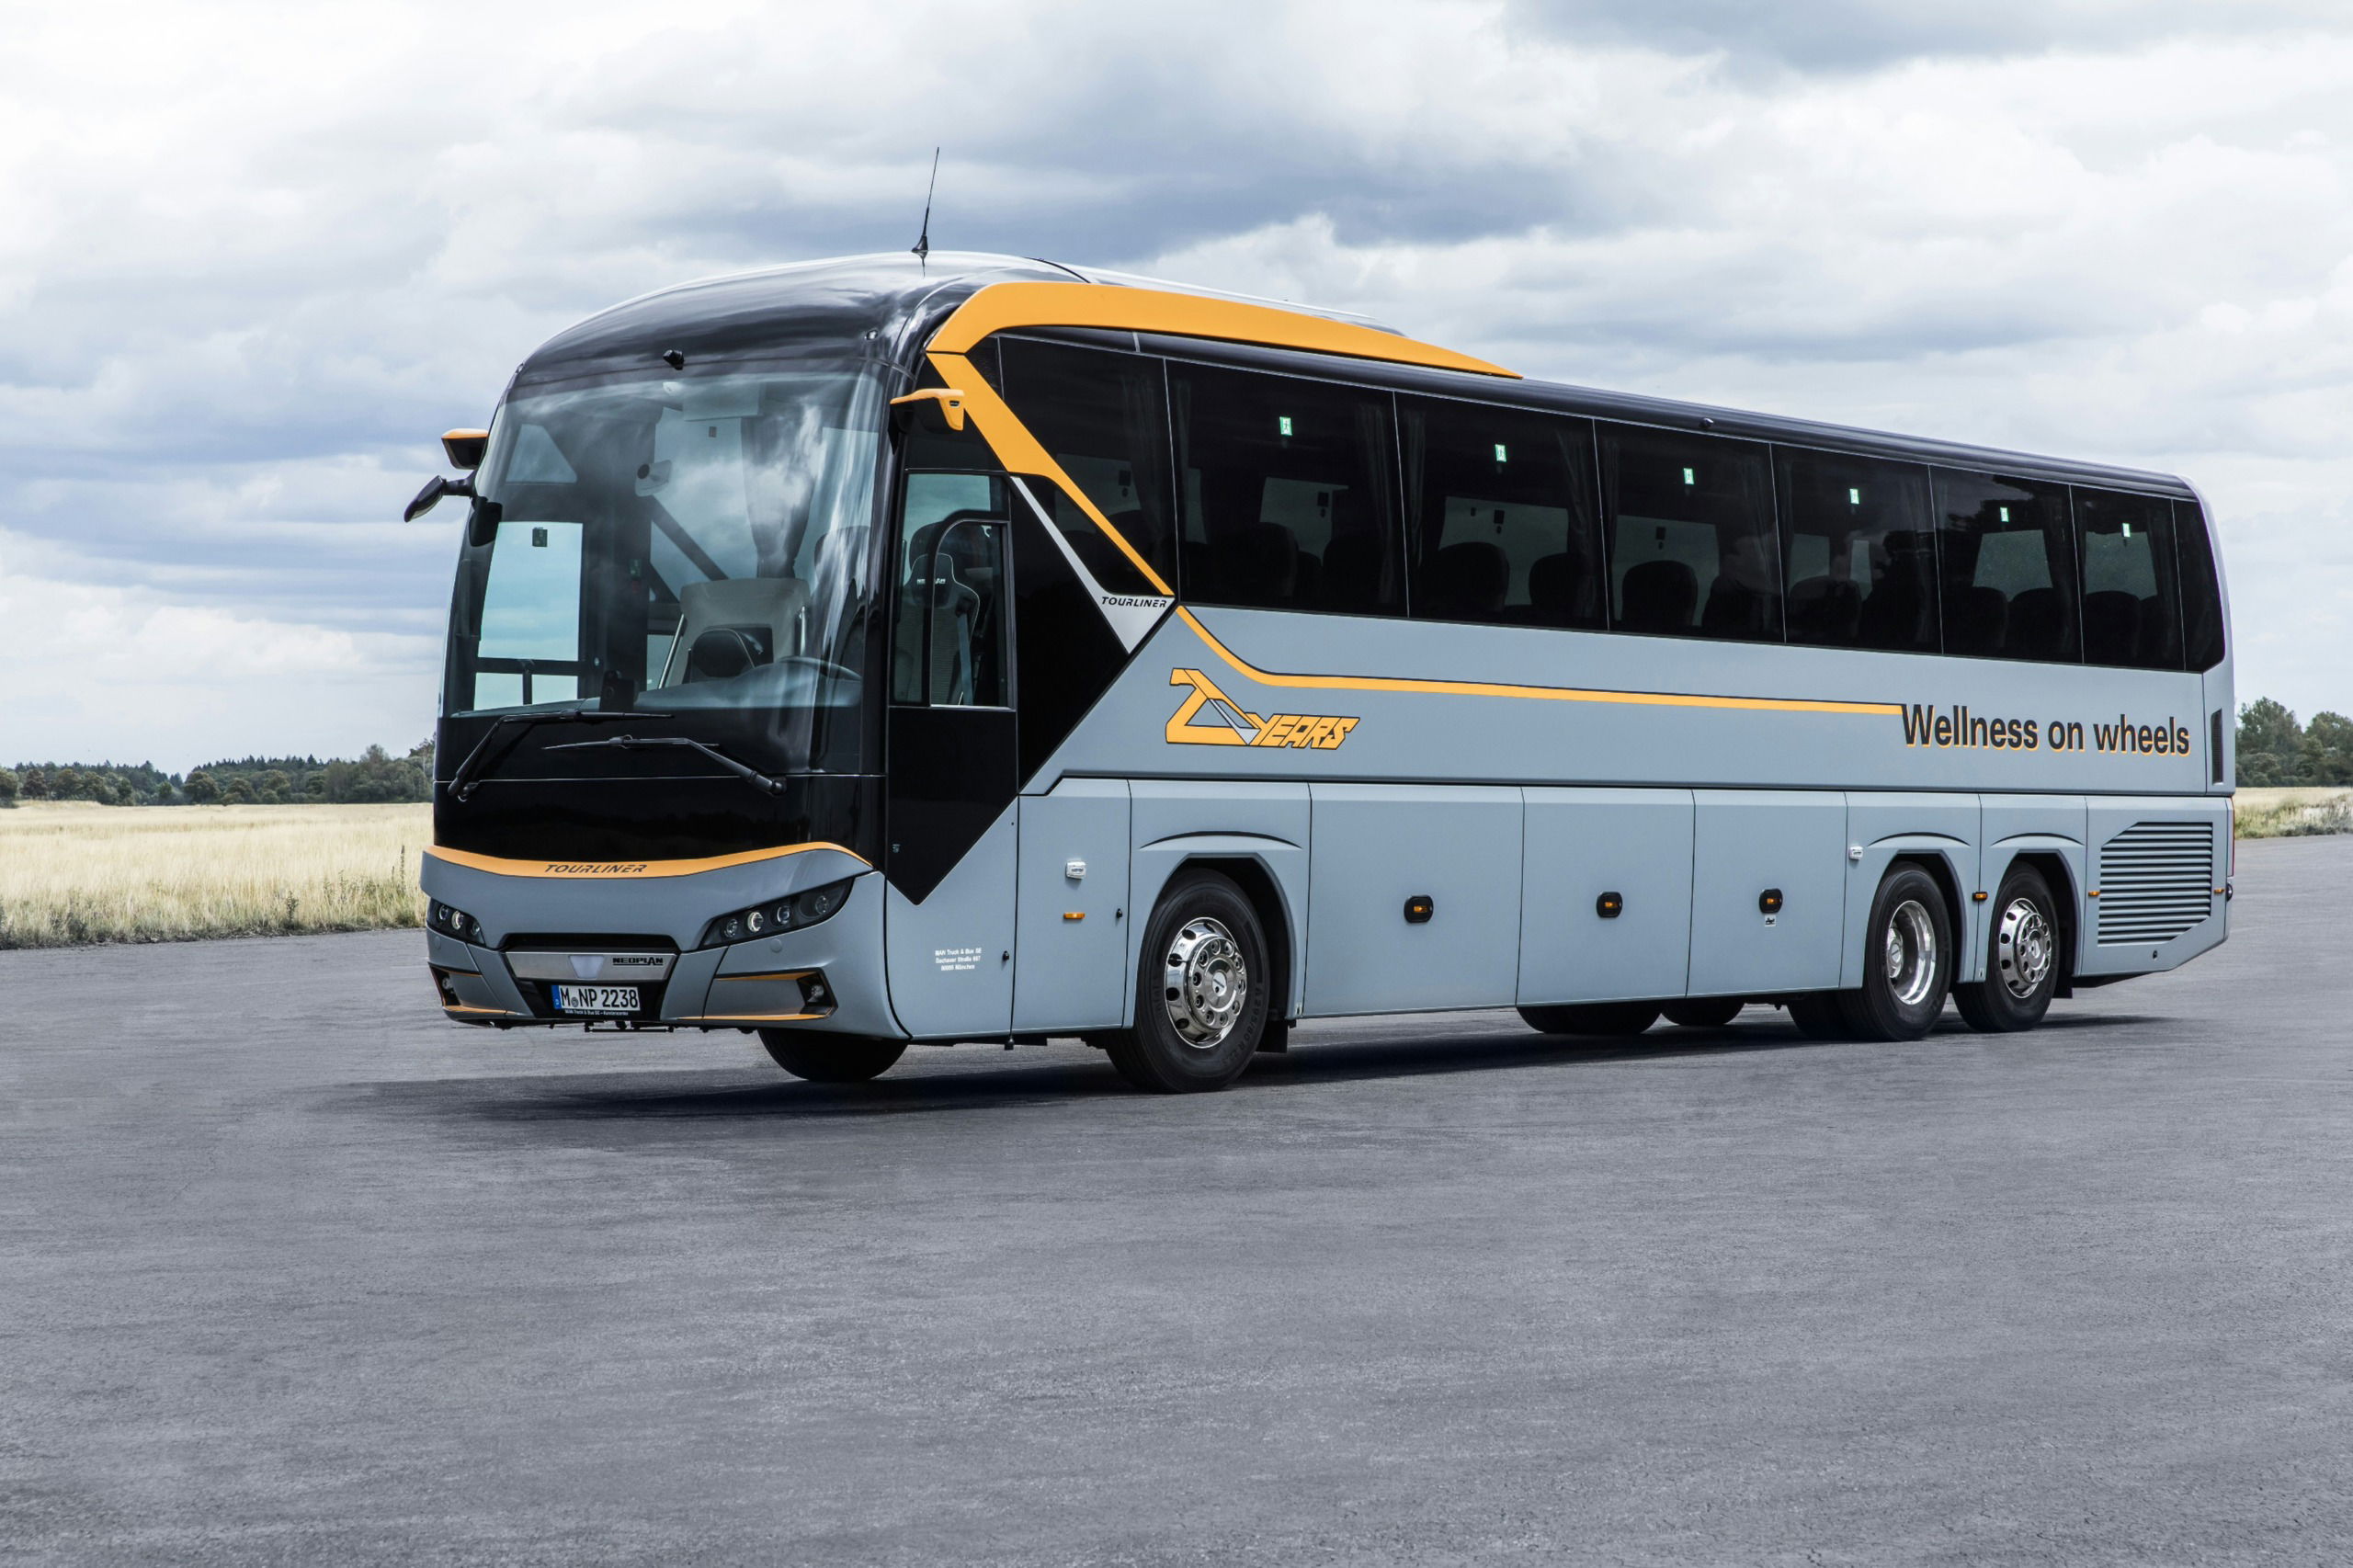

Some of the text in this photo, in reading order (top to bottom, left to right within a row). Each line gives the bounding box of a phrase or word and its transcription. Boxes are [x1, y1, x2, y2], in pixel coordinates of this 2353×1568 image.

[1101, 597, 1167, 608] TOURLINER
[1245, 712, 1360, 750] YEARS
[1901, 703, 2191, 756] Wellness on wheels
[544, 864, 648, 874] TOURLINER
[612, 957, 663, 966] NEOPLAN
[560, 987, 639, 1008] M NP 2238
